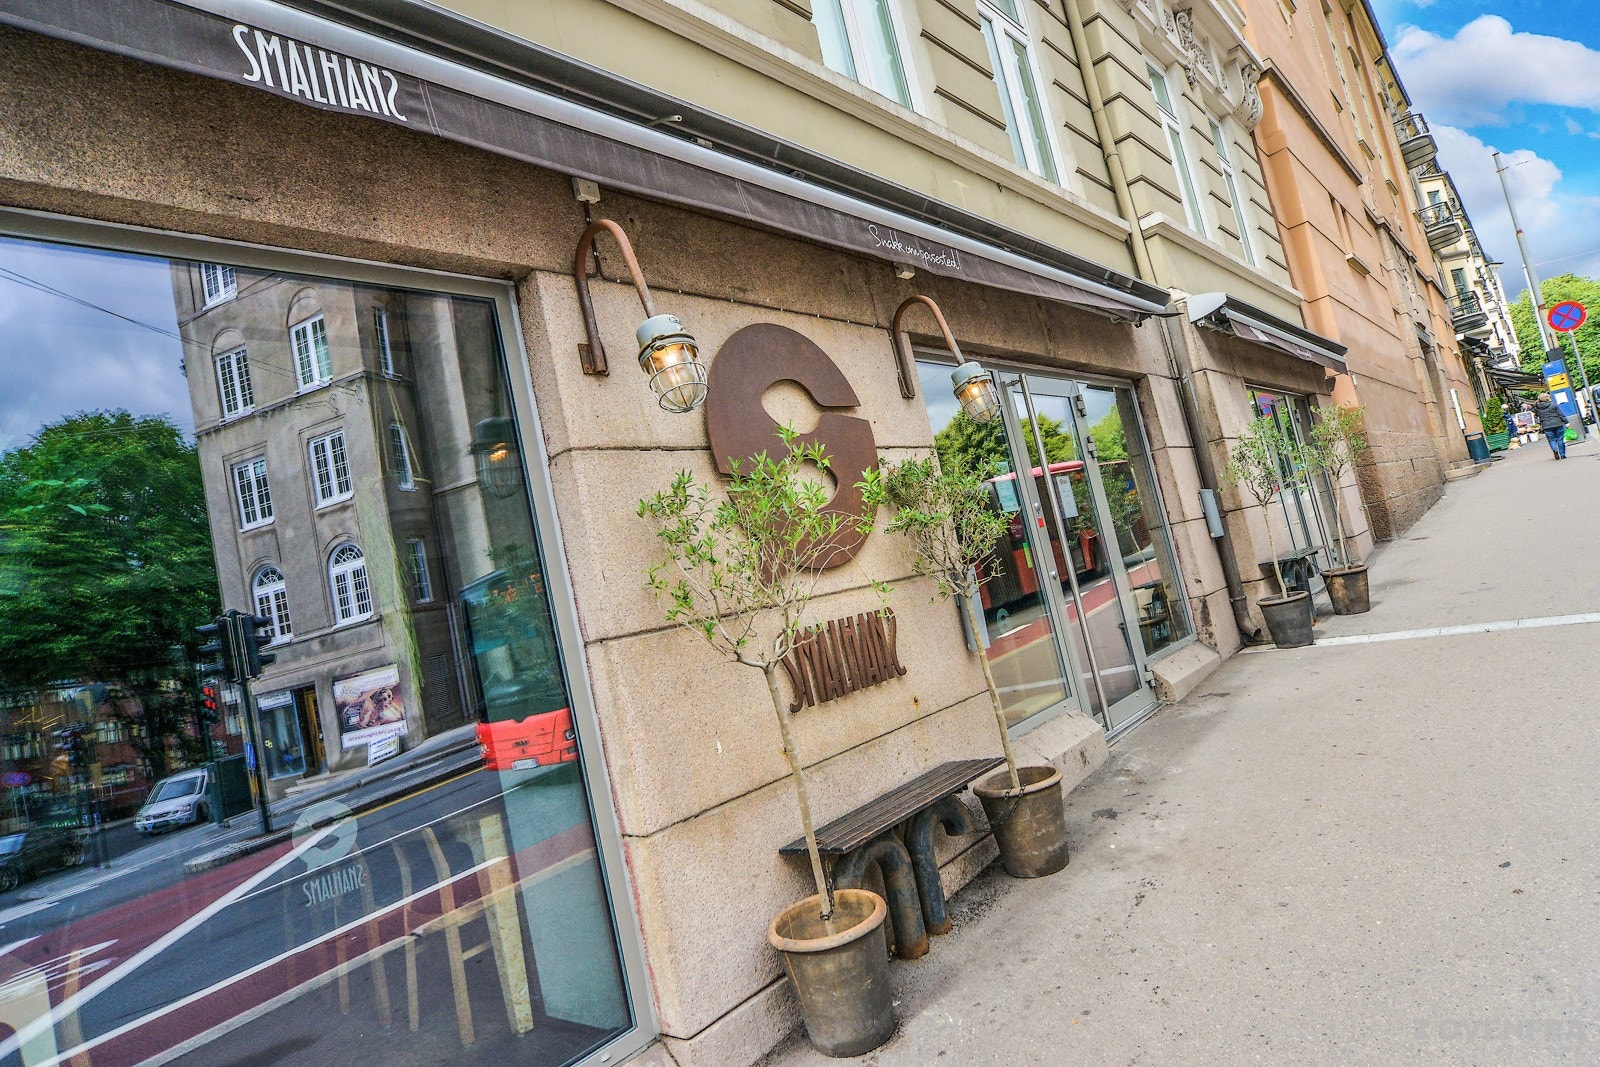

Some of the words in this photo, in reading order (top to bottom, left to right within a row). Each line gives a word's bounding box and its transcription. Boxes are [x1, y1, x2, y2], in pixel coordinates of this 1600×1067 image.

[232, 24, 408, 122] SMALHANS
[775, 606, 907, 713] SMALHANS
[302, 864, 365, 907] SMALHANS
